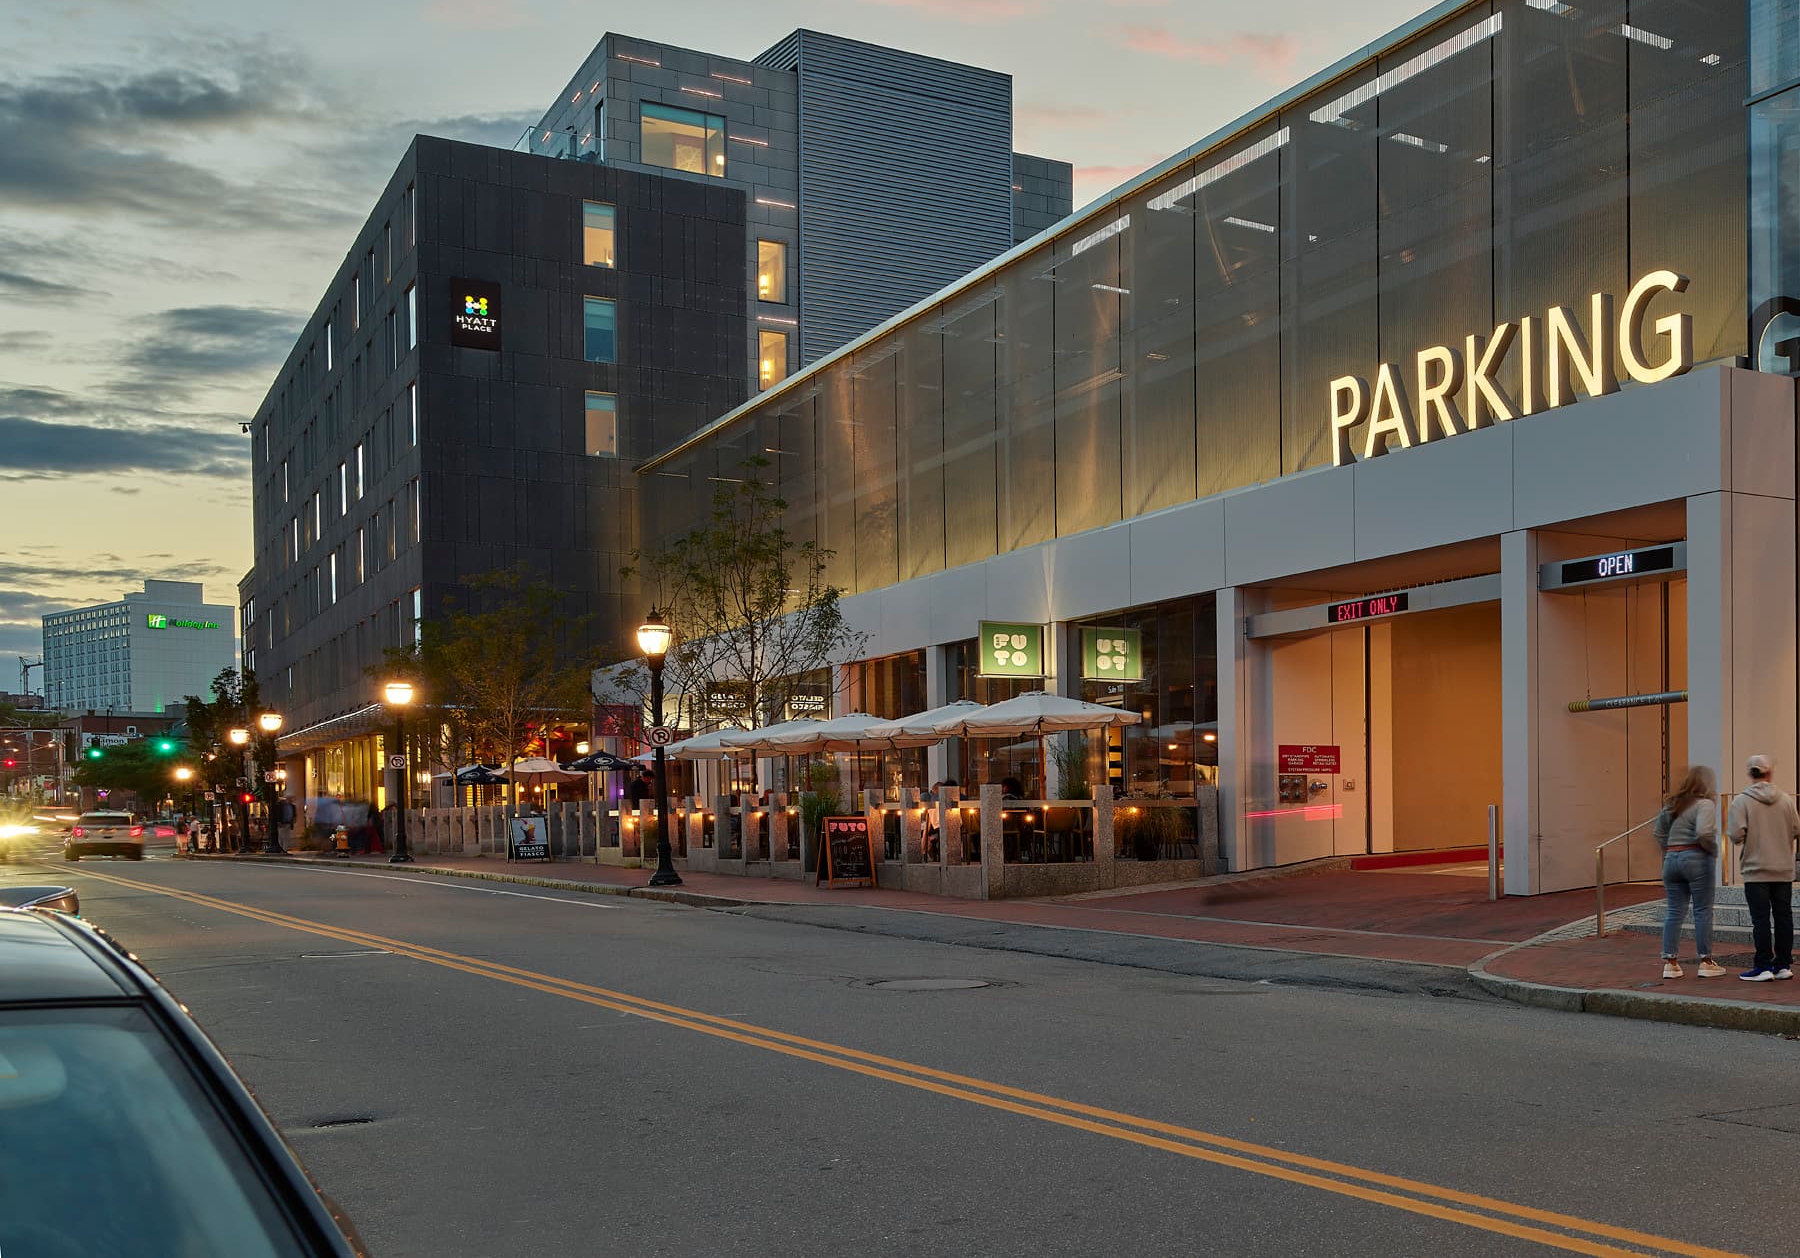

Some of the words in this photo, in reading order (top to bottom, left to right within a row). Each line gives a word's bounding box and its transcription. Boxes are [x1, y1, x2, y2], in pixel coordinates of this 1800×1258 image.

[456, 315, 497, 327] HYATT
[462, 323, 492, 333] PLACE
[1330, 269, 1693, 467] PARKING
[1598, 553, 1633, 577] OPEN
[1337, 602, 1363, 621] EXIT
[1369, 596, 1398, 615] ONLY
[169, 618, 203, 630] Holiday
[204, 620, 220, 630] Inn
[993, 633, 1028, 649] FU
[993, 650, 1028, 667] TO
[829, 822, 867, 833] FUTO
